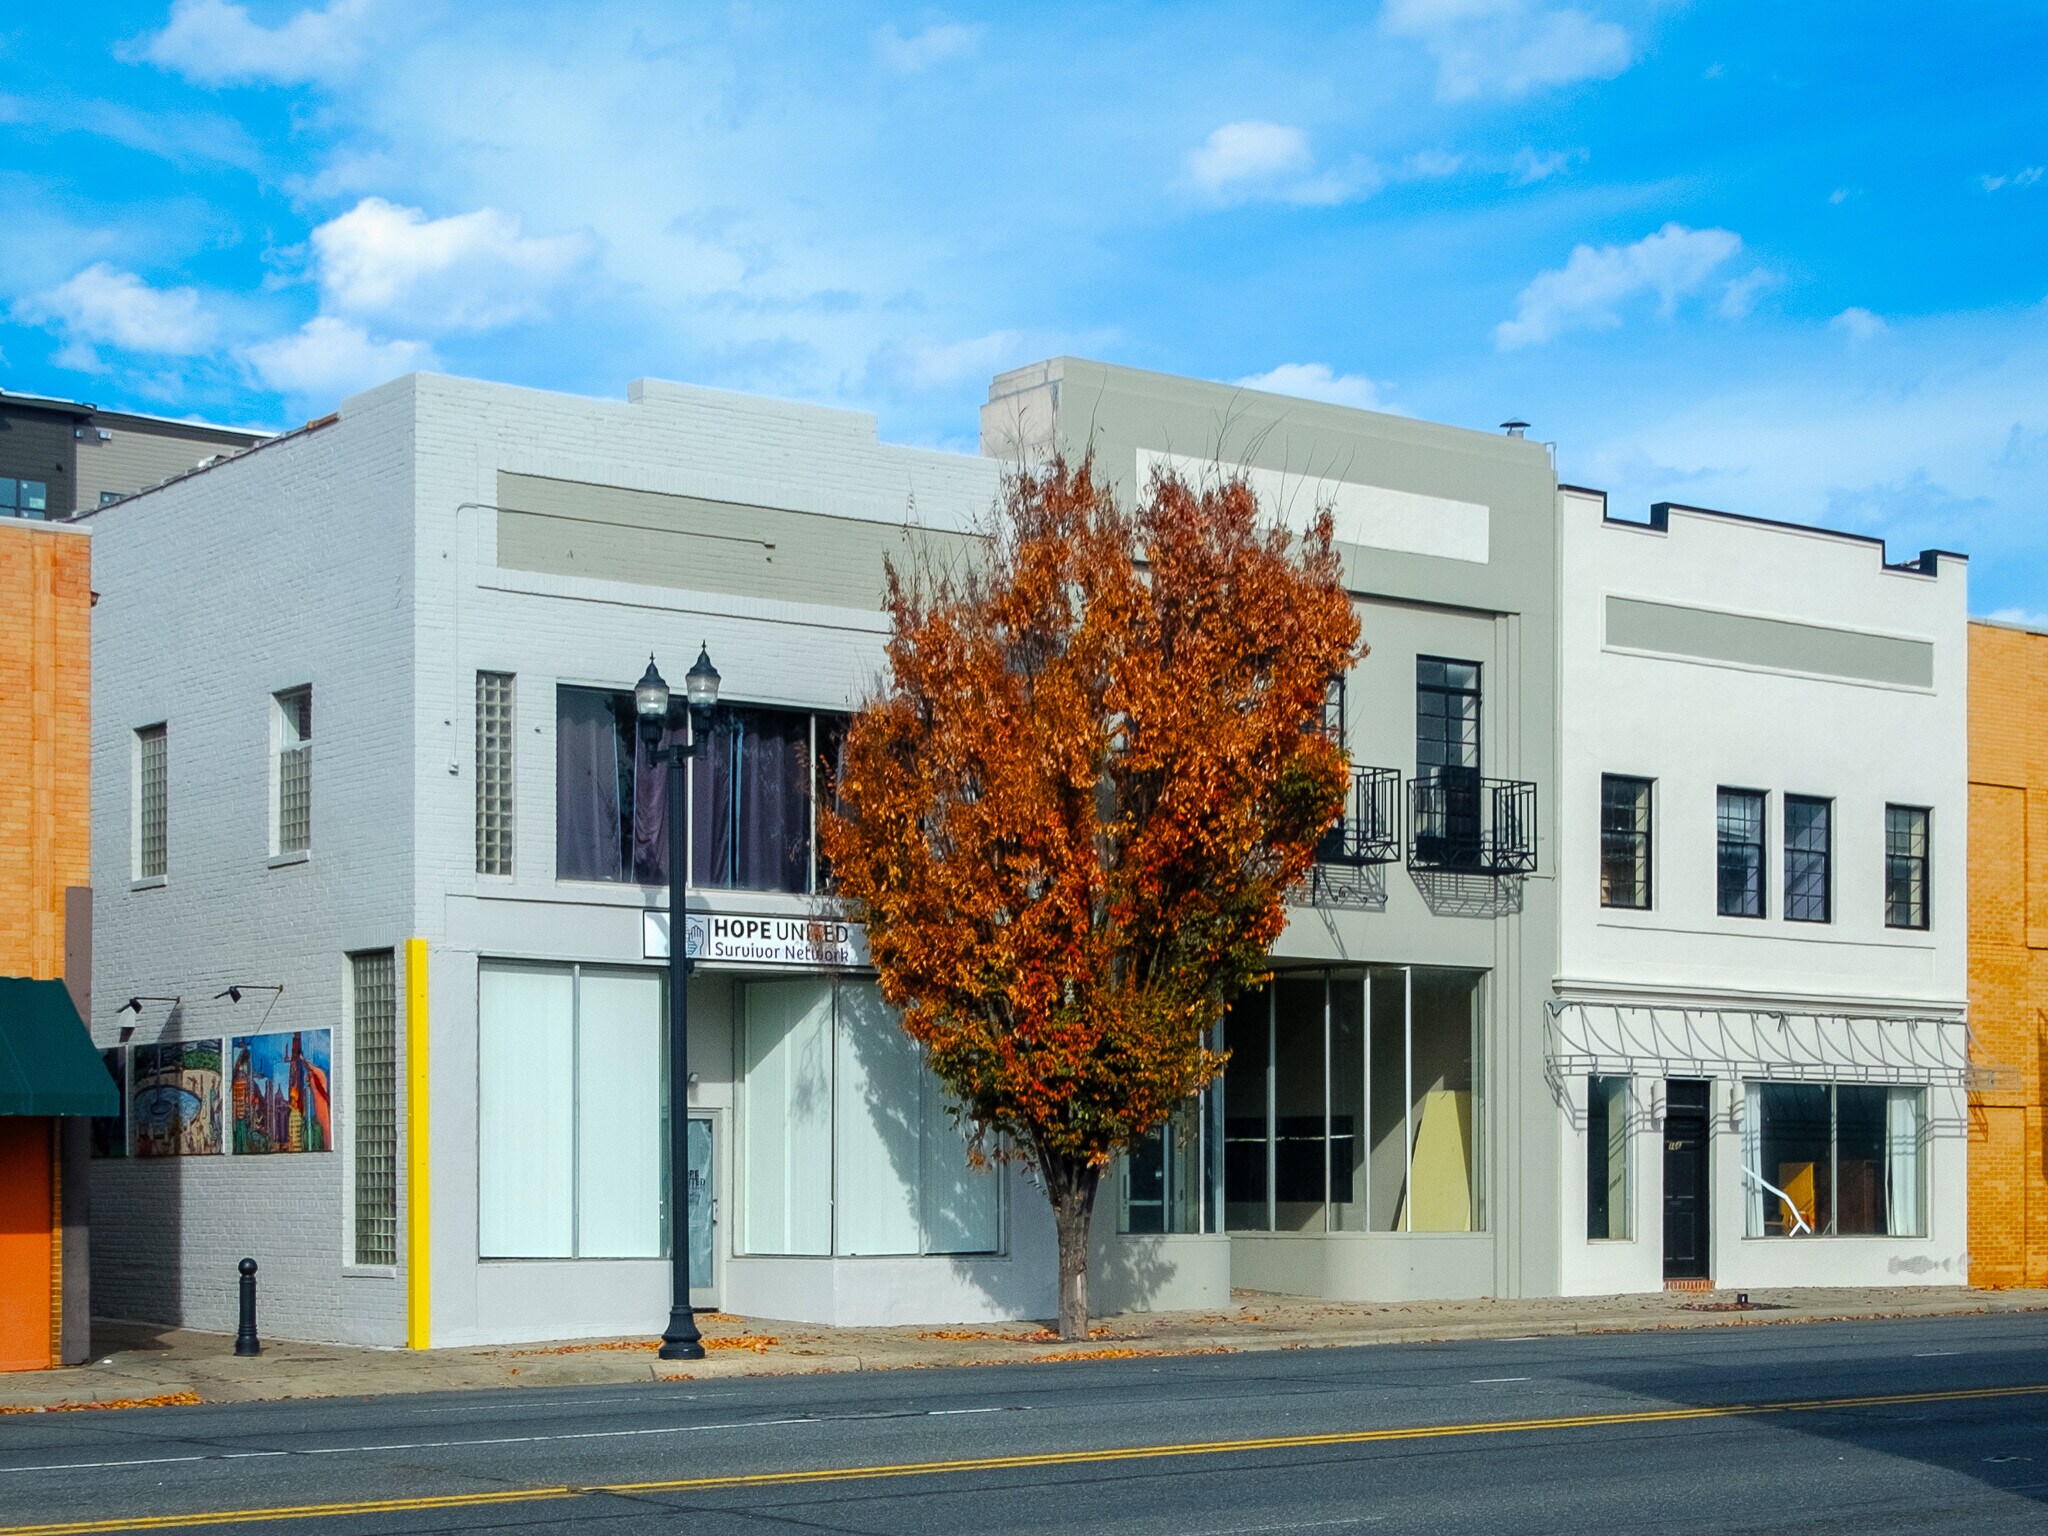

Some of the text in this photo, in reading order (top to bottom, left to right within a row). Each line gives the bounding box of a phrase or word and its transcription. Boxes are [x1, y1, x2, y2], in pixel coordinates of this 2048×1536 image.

[714, 919, 849, 943] HOPE UNIED
[715, 942, 849, 962] Survivor Network
